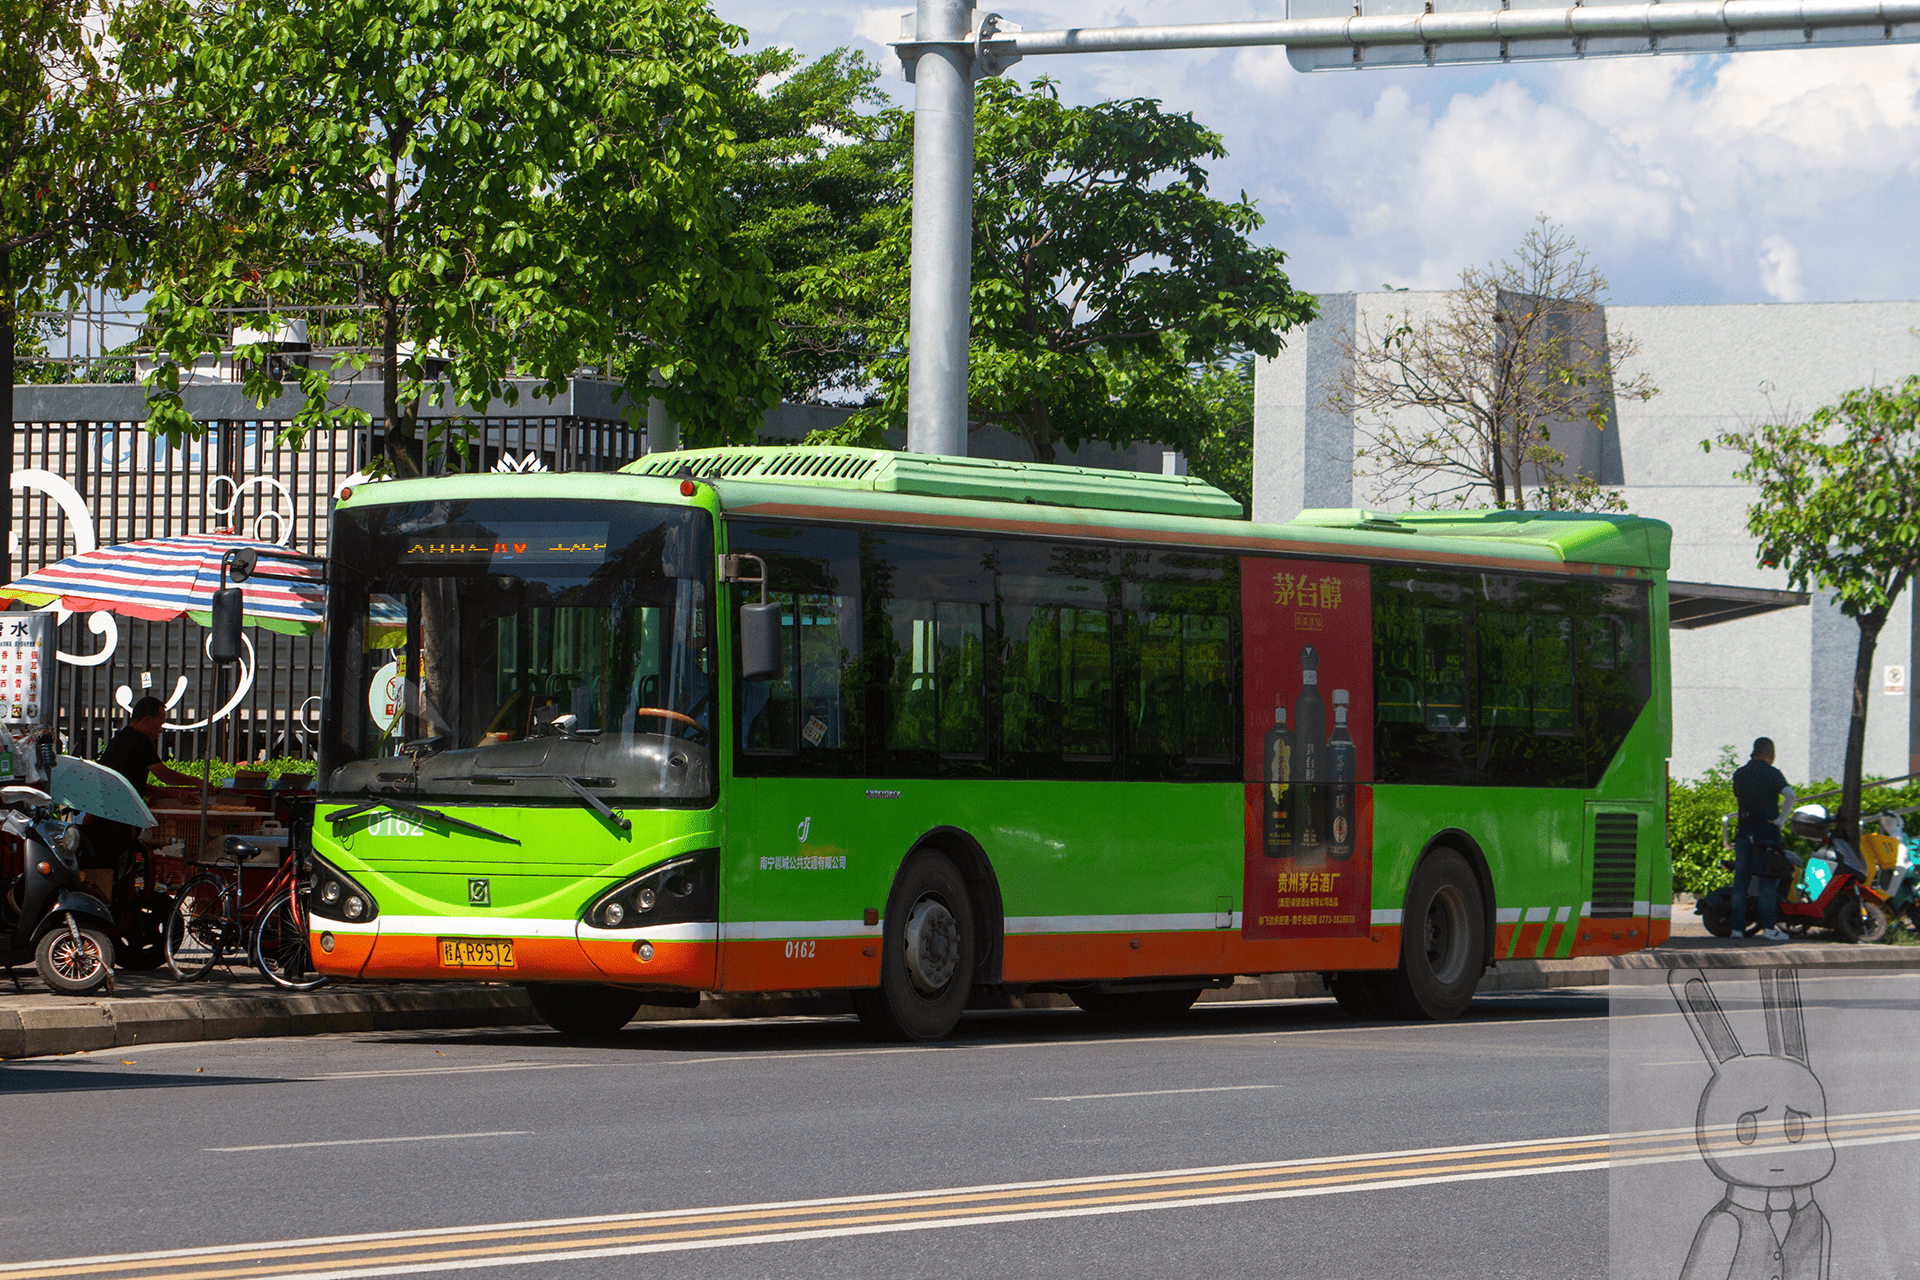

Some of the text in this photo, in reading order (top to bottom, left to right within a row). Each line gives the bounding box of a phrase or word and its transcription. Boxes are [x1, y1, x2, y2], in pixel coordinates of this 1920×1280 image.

[1273, 573, 1342, 609] 茅台醇
[367, 811, 425, 836] 0162
[760, 856, 846, 870] 南宁邕城公共交通有限公司
[1278, 873, 1341, 893] 贵州茅台酒厂
[785, 941, 816, 958] 0162
